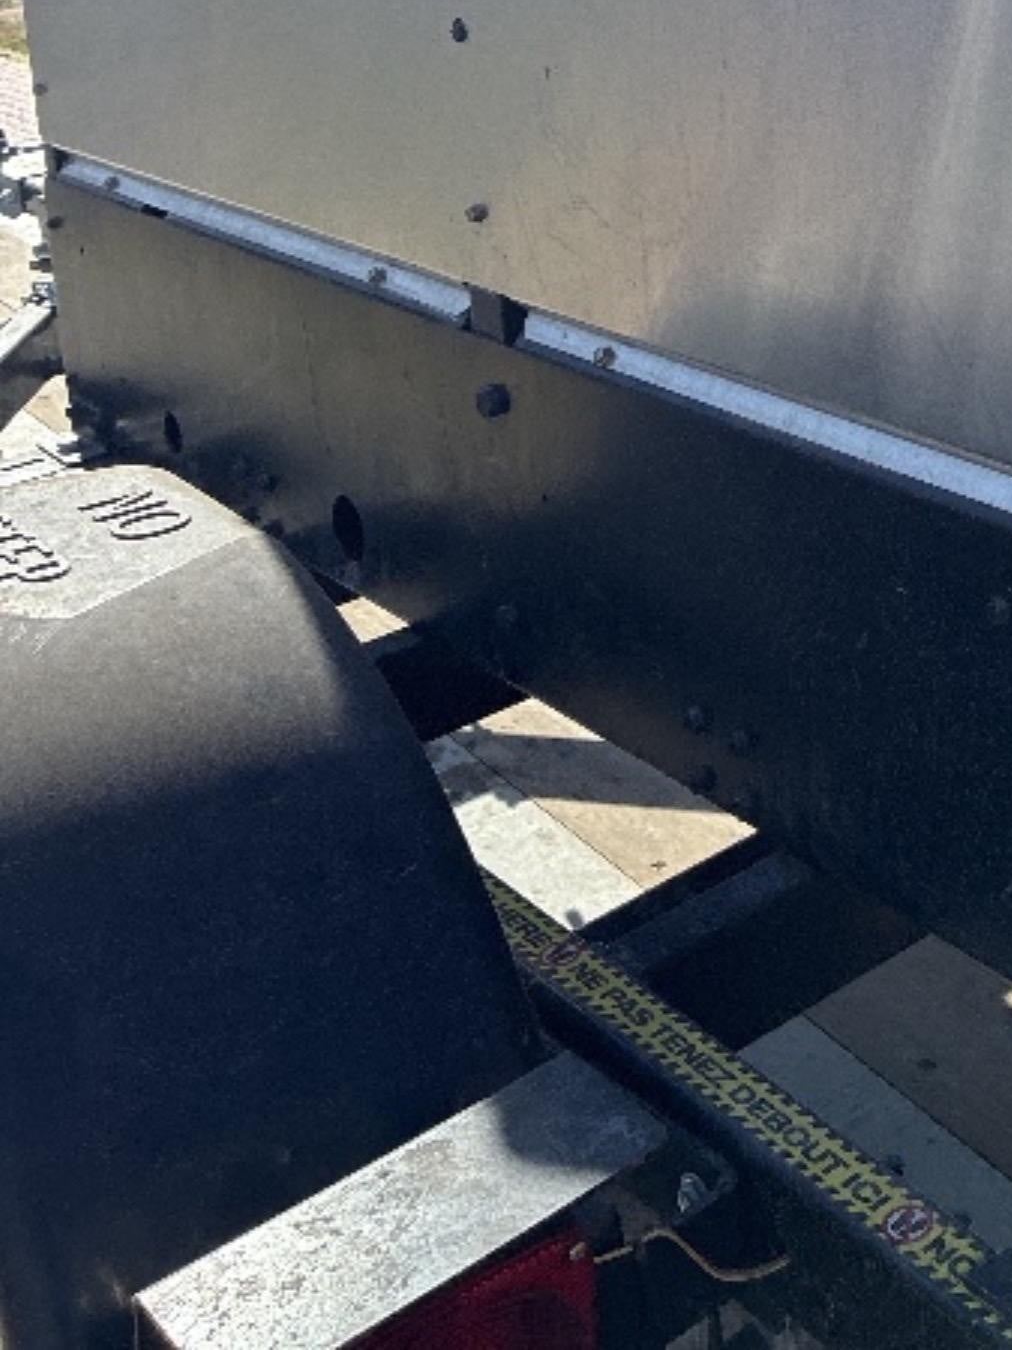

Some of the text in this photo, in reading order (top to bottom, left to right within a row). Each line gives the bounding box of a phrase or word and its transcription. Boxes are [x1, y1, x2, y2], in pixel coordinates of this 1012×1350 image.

[602, 984, 656, 1028] PAS
[651, 1022, 739, 1086] TENEZ
[728, 1083, 852, 1175] DEBOUT
[842, 1172, 892, 1211] ICI
